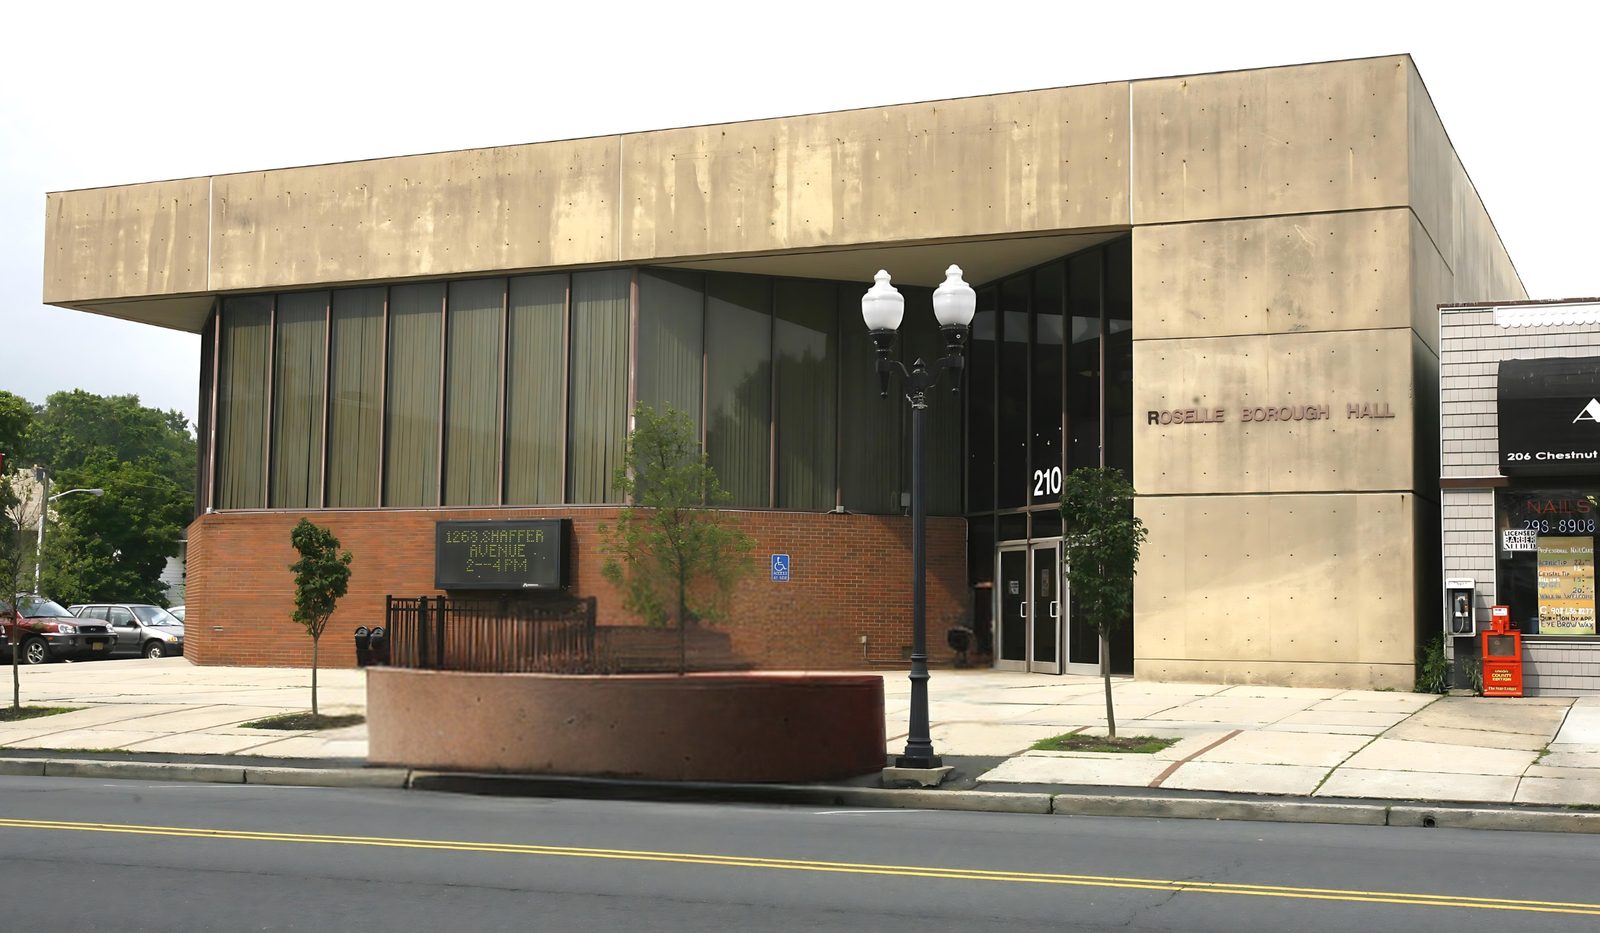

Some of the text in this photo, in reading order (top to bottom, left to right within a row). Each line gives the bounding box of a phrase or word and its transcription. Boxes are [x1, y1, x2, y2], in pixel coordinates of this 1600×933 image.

[1147, 402, 1396, 425] ROSELLE BOROUGH HALL
[1507, 450, 1598, 461] 206 Chestnut
[1033, 466, 1062, 496] 210
[1527, 499, 1591, 514] NAILS
[1523, 519, 1595, 533] 298-8908
[480, 529, 544, 543] SHAFFER
[469, 544, 526, 558] AVENUE
